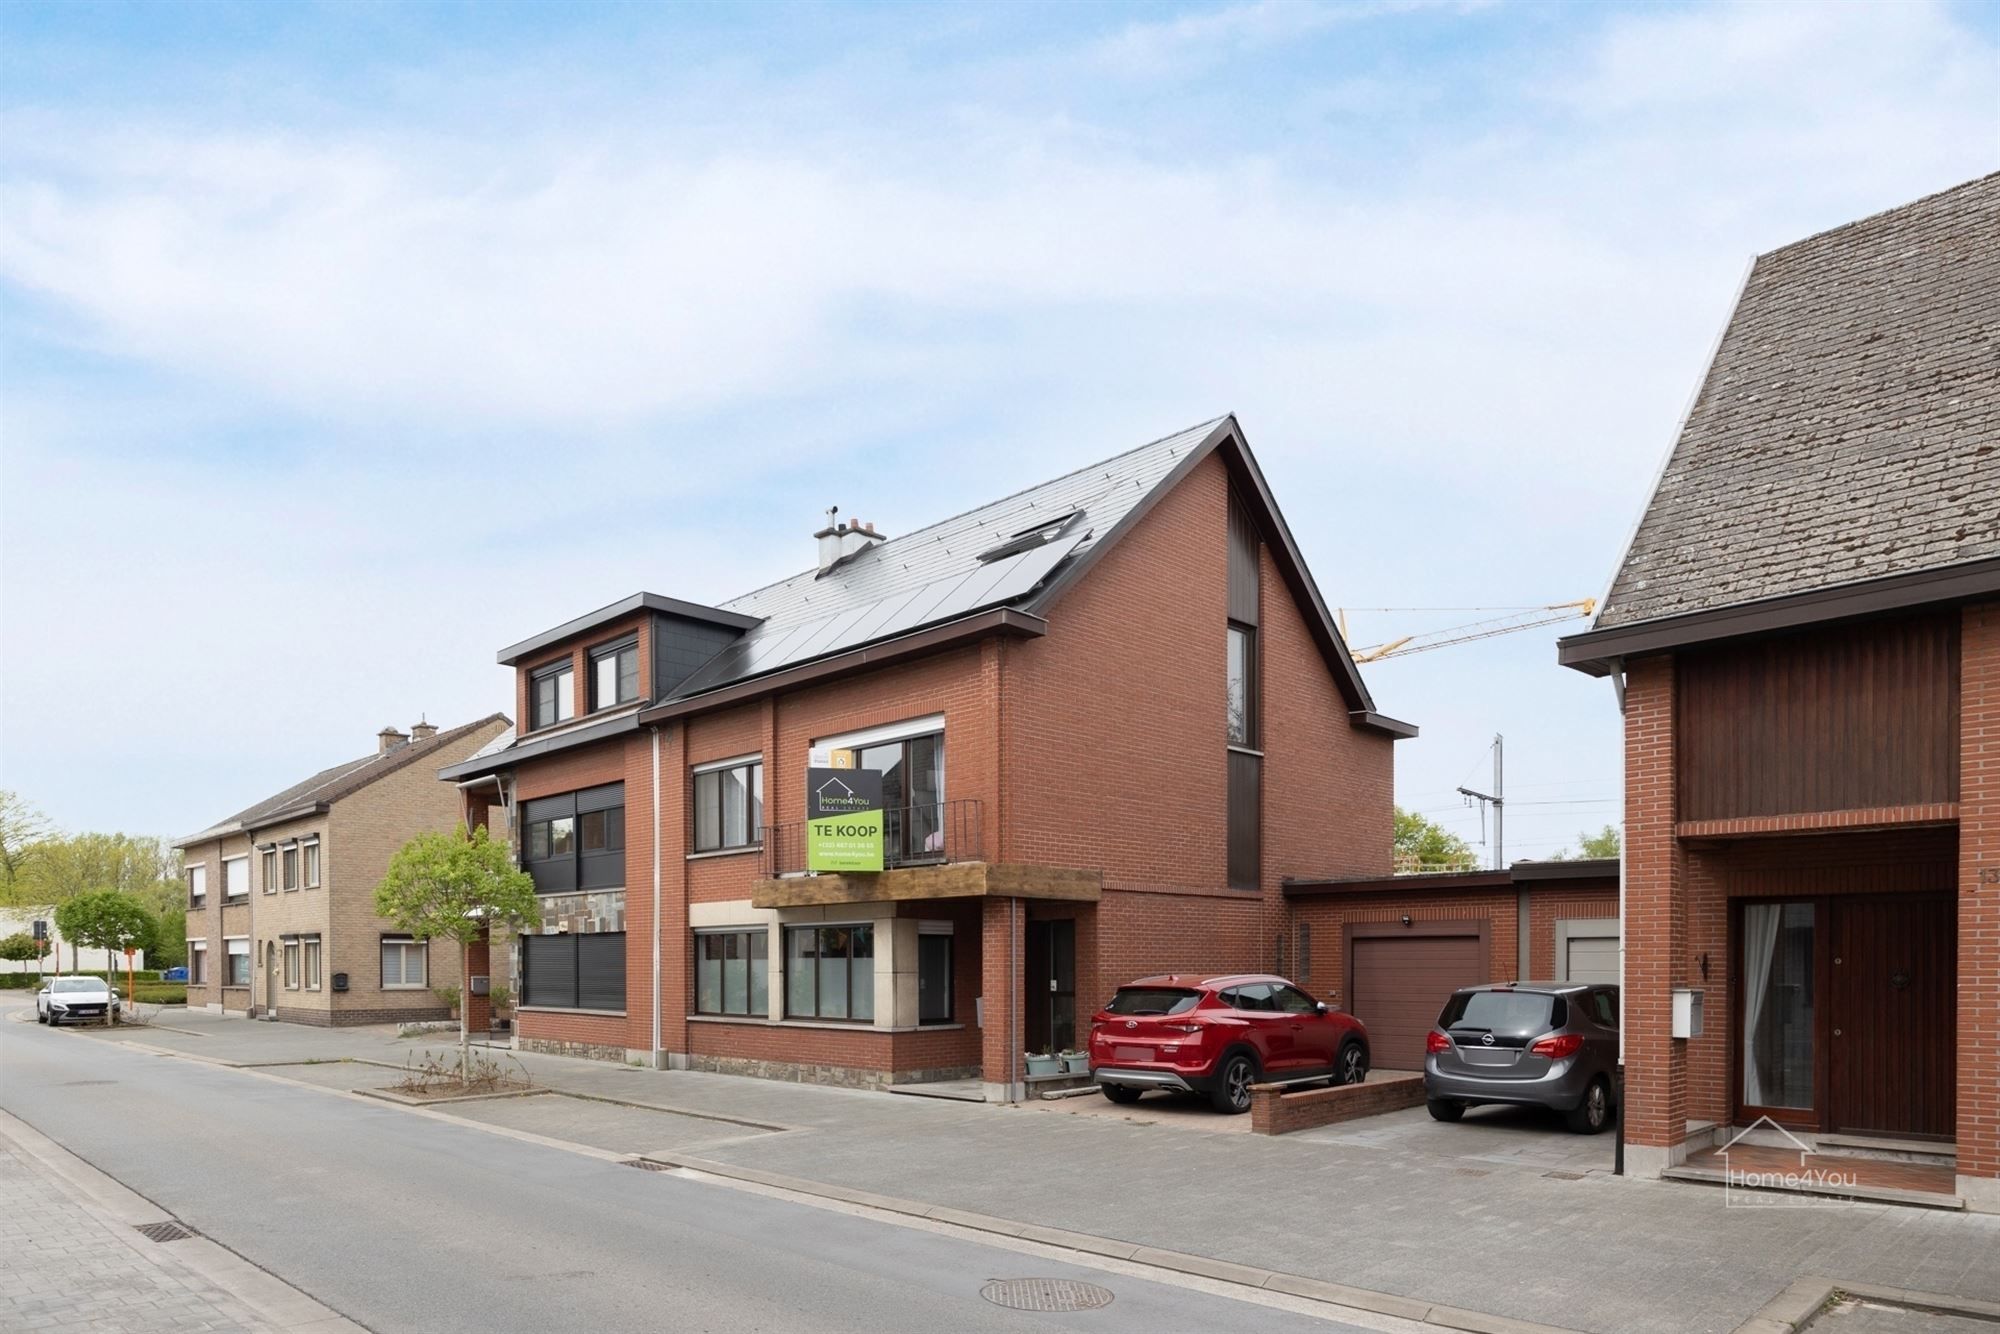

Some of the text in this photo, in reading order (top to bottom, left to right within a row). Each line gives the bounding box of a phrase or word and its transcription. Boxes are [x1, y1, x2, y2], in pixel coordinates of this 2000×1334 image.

[821, 796, 870, 806] Home4You
[814, 825, 878, 837] TE KOOP
